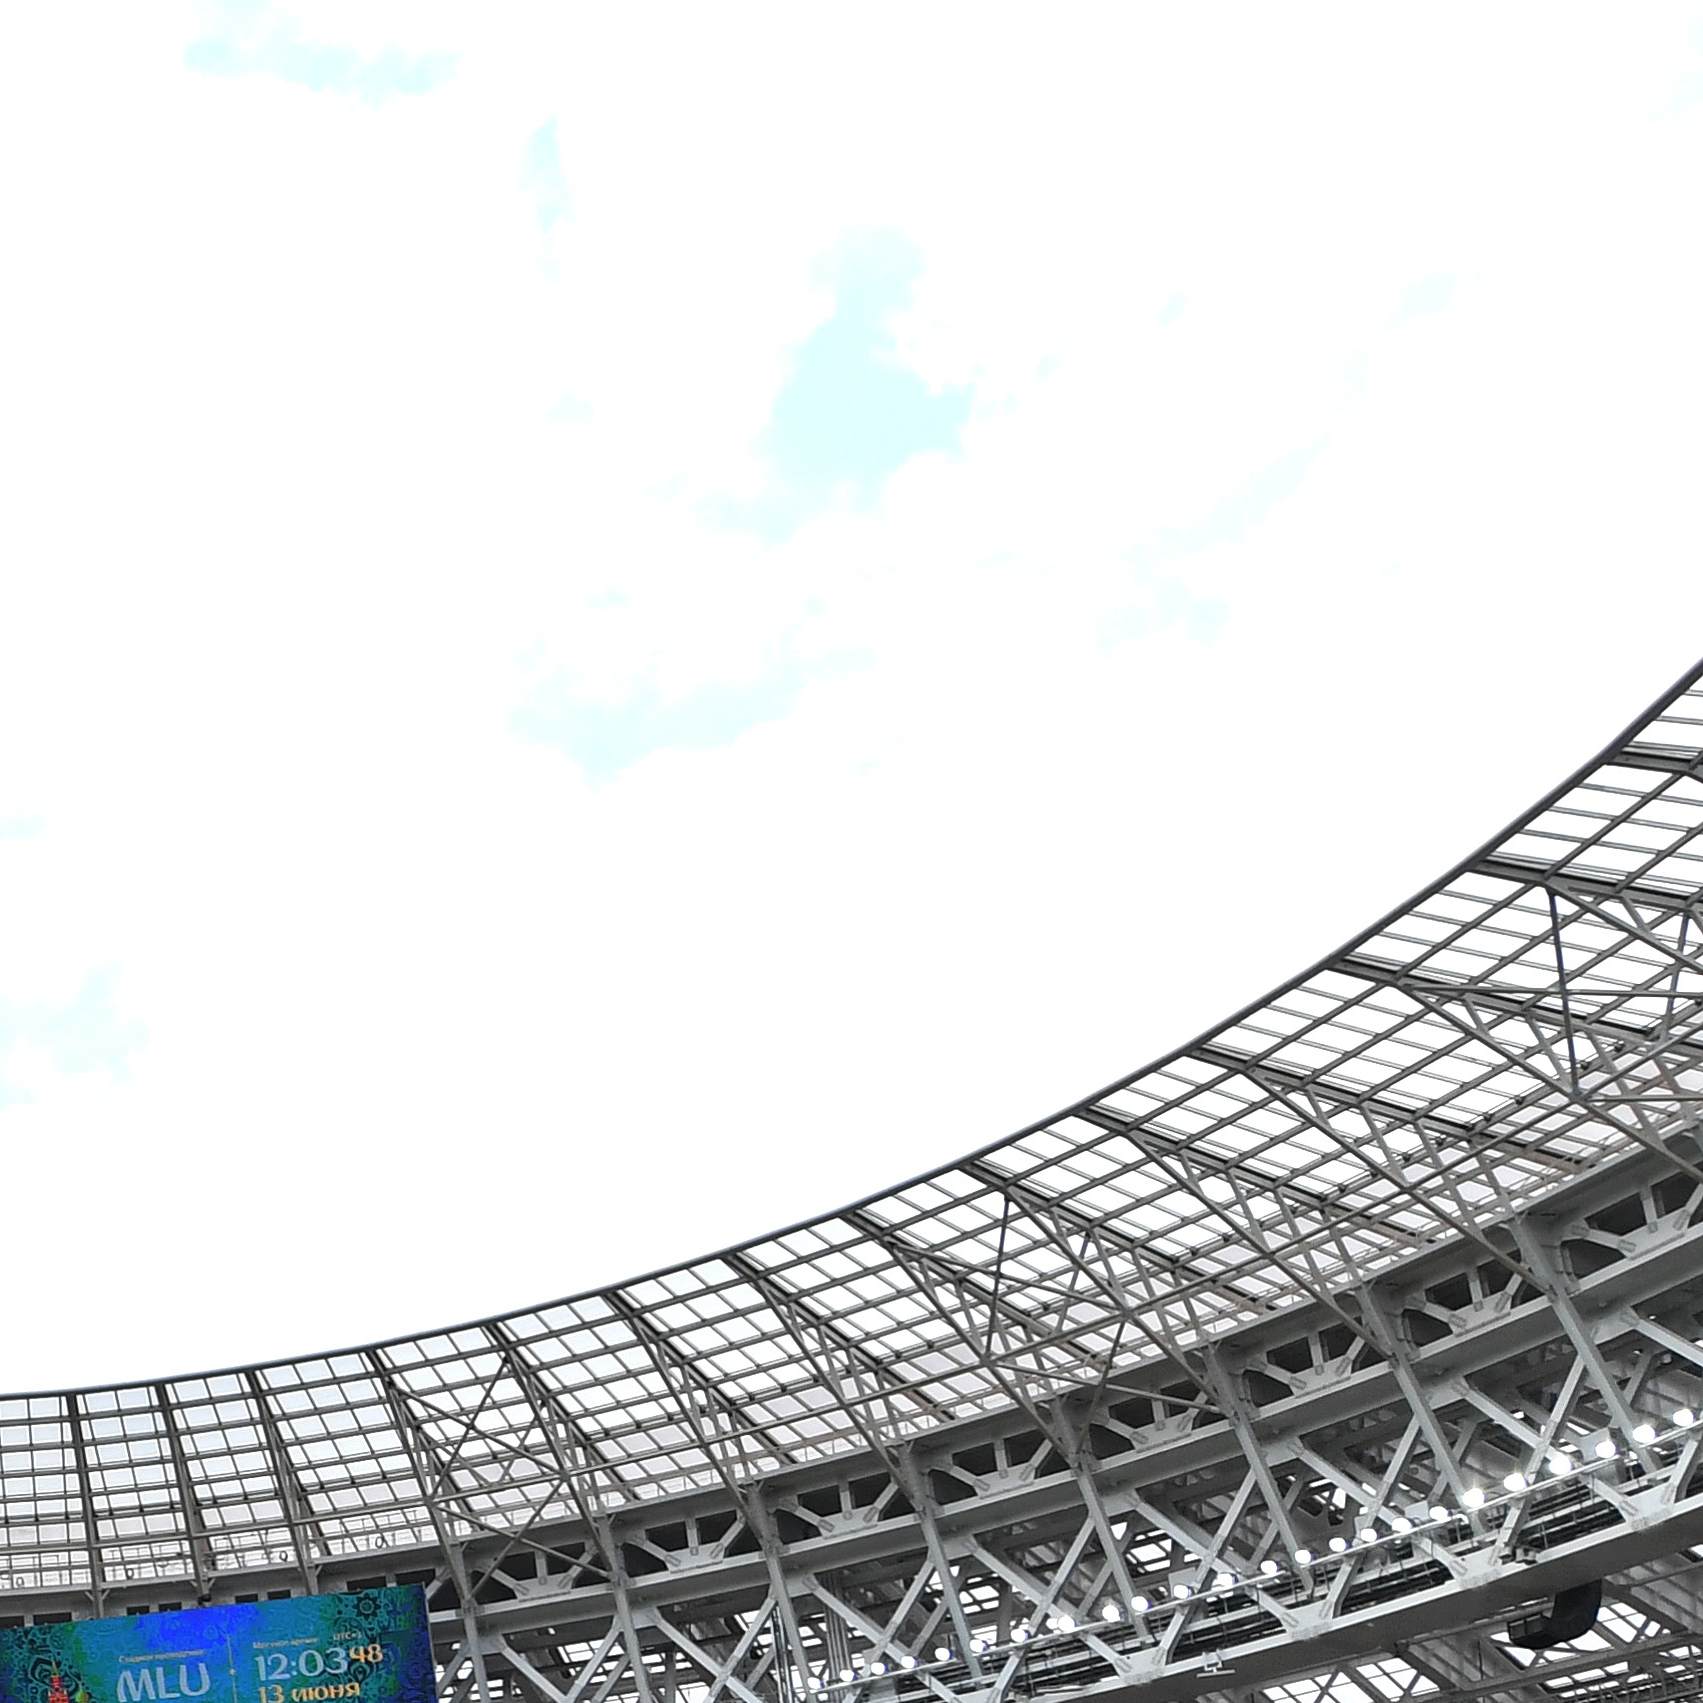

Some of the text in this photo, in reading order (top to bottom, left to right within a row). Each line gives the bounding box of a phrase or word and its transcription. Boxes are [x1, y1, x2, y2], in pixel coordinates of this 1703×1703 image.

[254, 1647, 348, 1681] 12:03
[116, 1663, 211, 1703] MLU
[291, 1681, 360, 1703] июня
